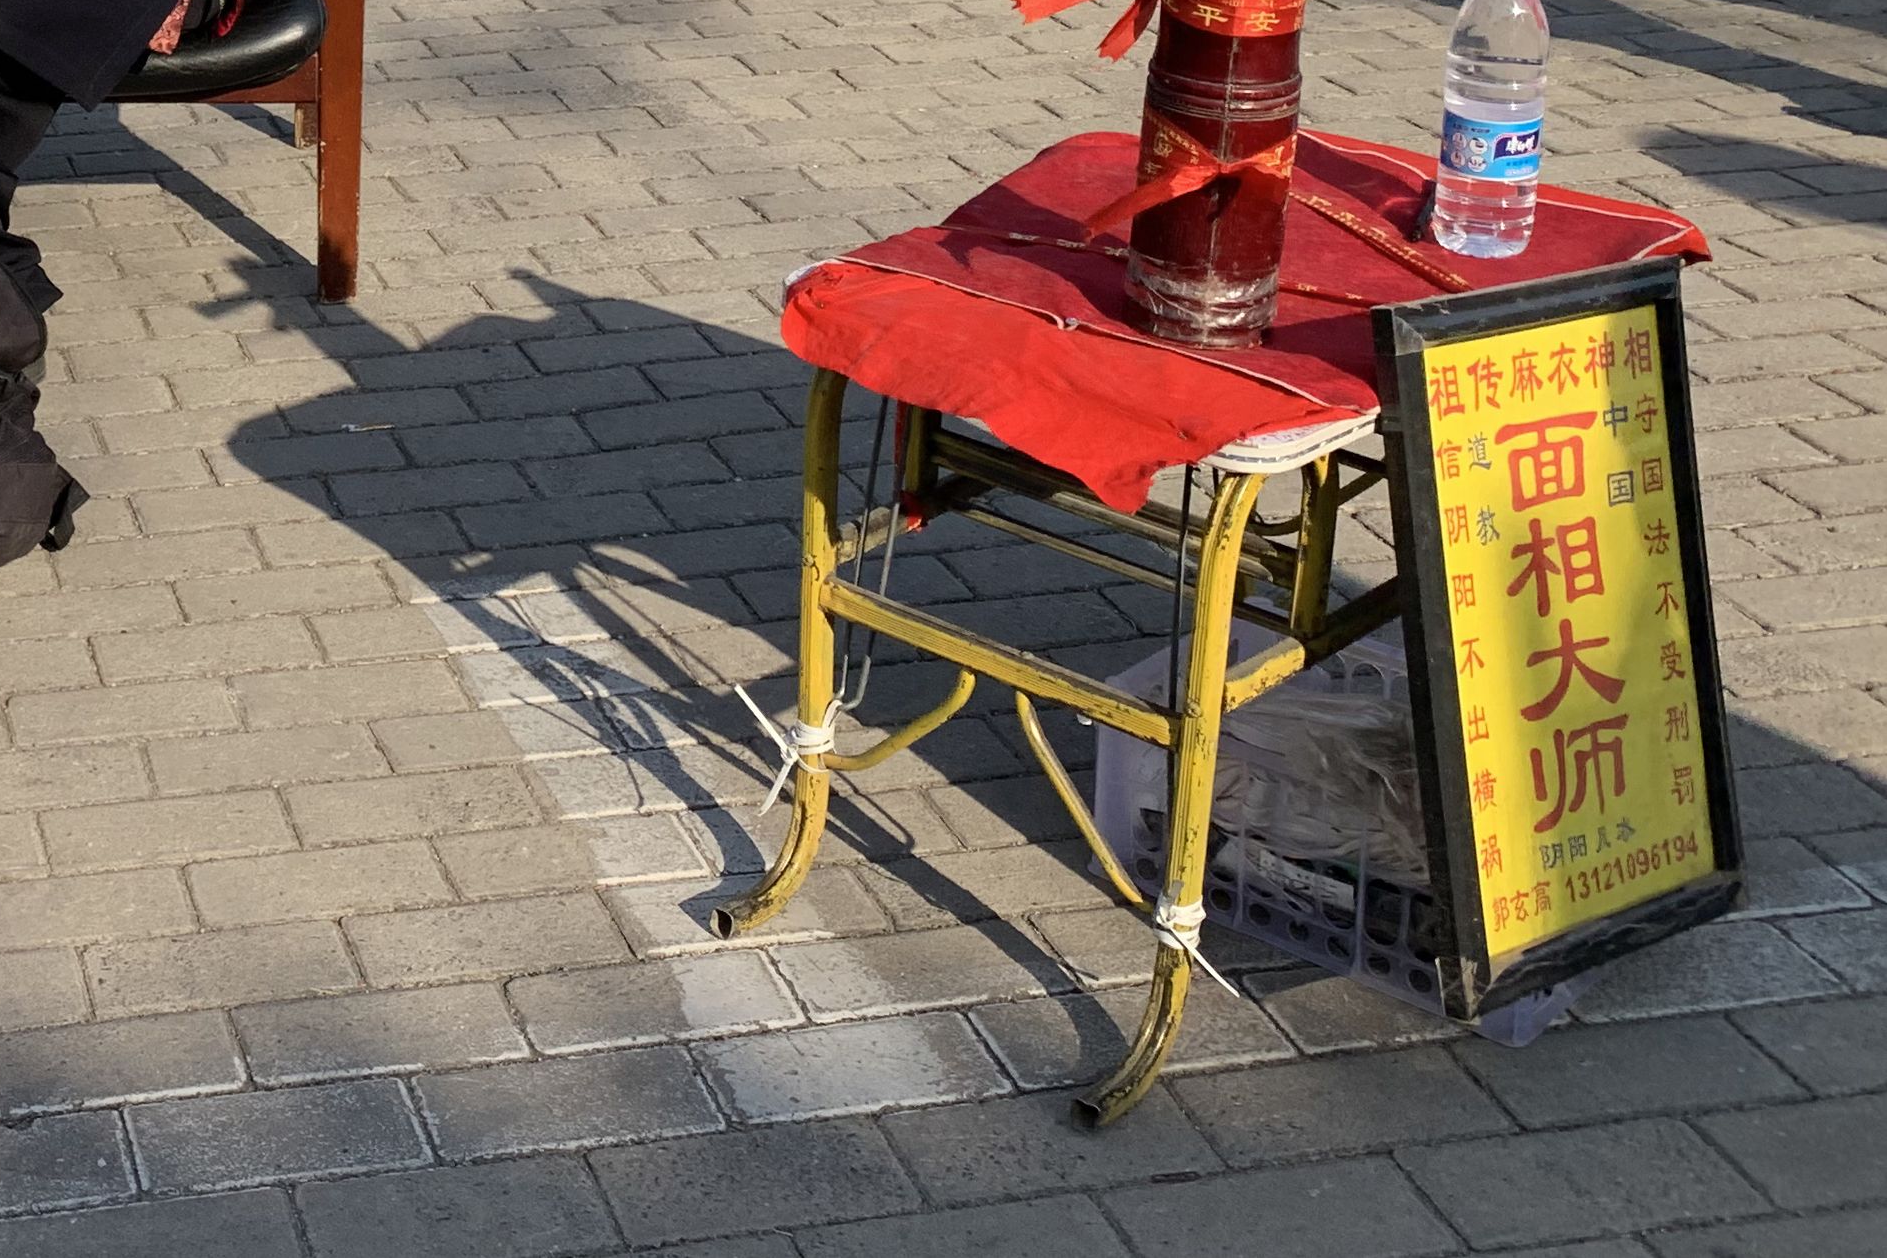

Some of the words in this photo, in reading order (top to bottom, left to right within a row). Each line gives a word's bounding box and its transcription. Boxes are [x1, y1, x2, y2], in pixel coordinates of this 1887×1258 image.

[1429, 327, 1652, 421] 祖传麻衣神相
[1467, 432, 1501, 546] 道教
[1603, 400, 1634, 507] 中国
[1494, 411, 1629, 833] 面相大师
[1635, 393, 1696, 806] 守国法不受刑罚
[1435, 439, 1503, 880] 信阴阳不出横祸
[1566, 831, 1699, 902] 13121096194
